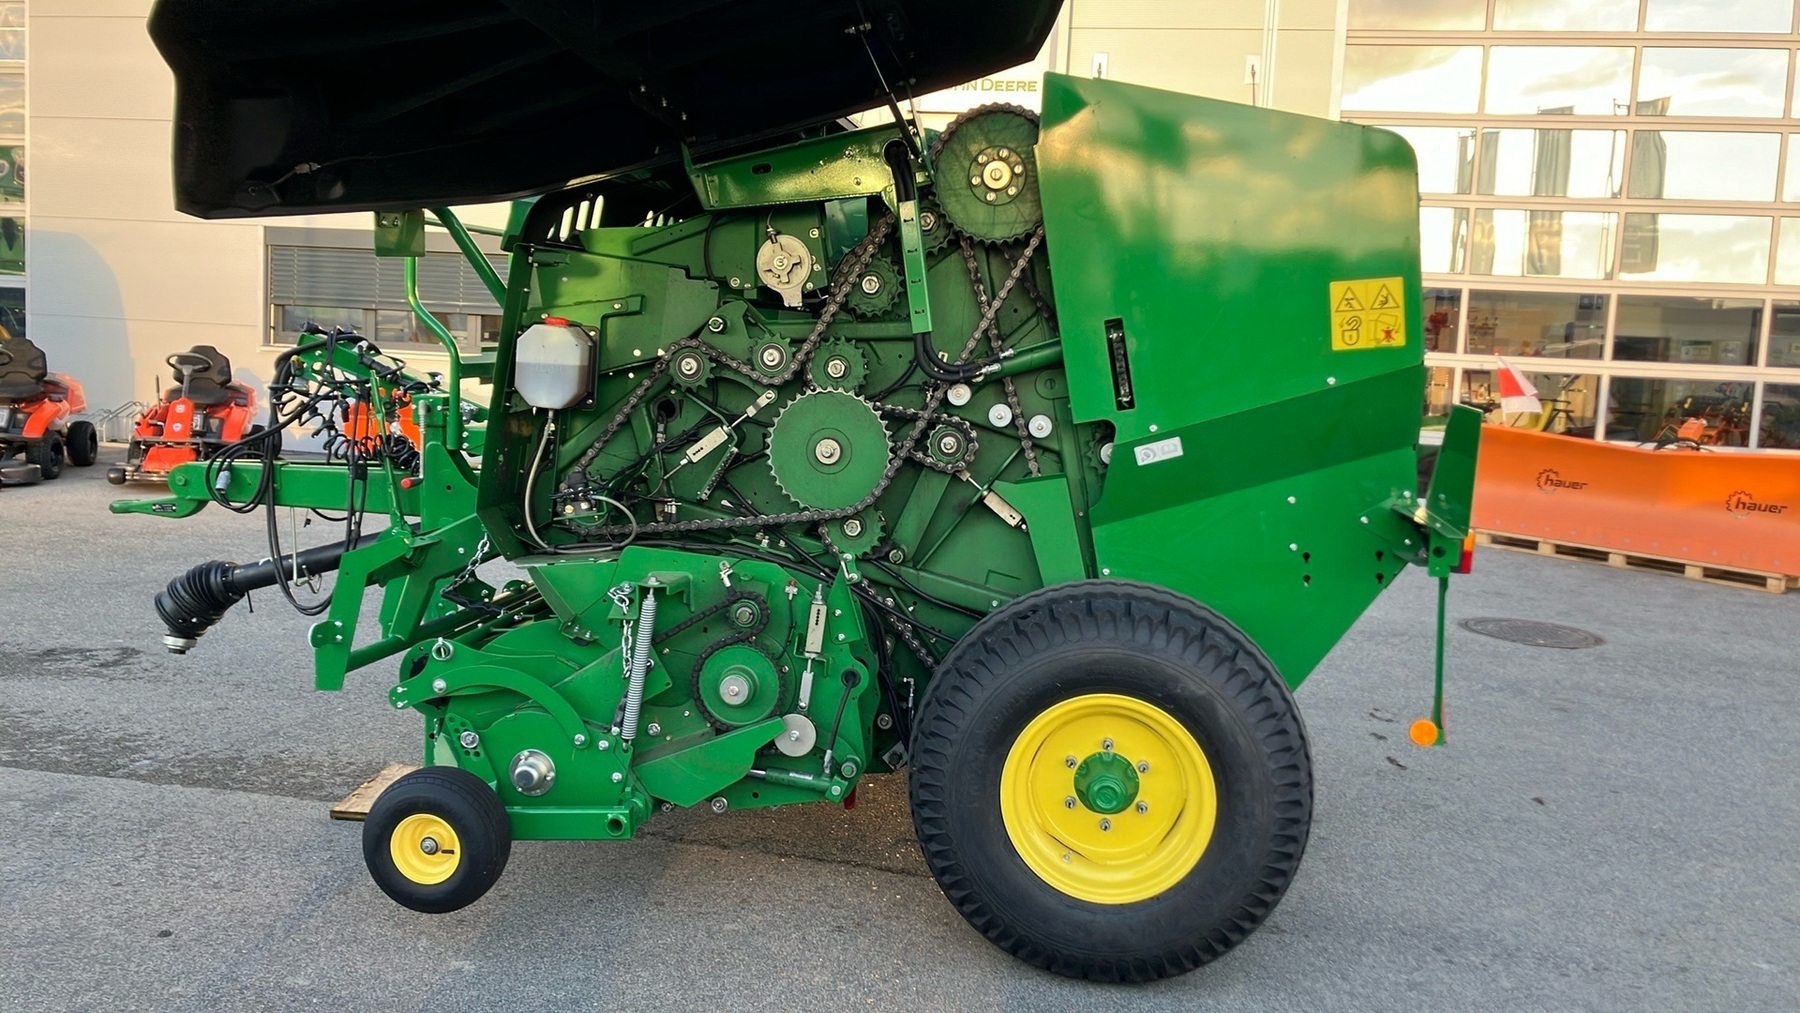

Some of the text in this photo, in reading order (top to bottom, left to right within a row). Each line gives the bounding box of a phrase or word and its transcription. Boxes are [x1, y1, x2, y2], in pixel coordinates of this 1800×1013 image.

[981, 79, 1038, 91] DEERE
[1544, 474, 1588, 489] hauer
[1735, 497, 1788, 513] hauer
